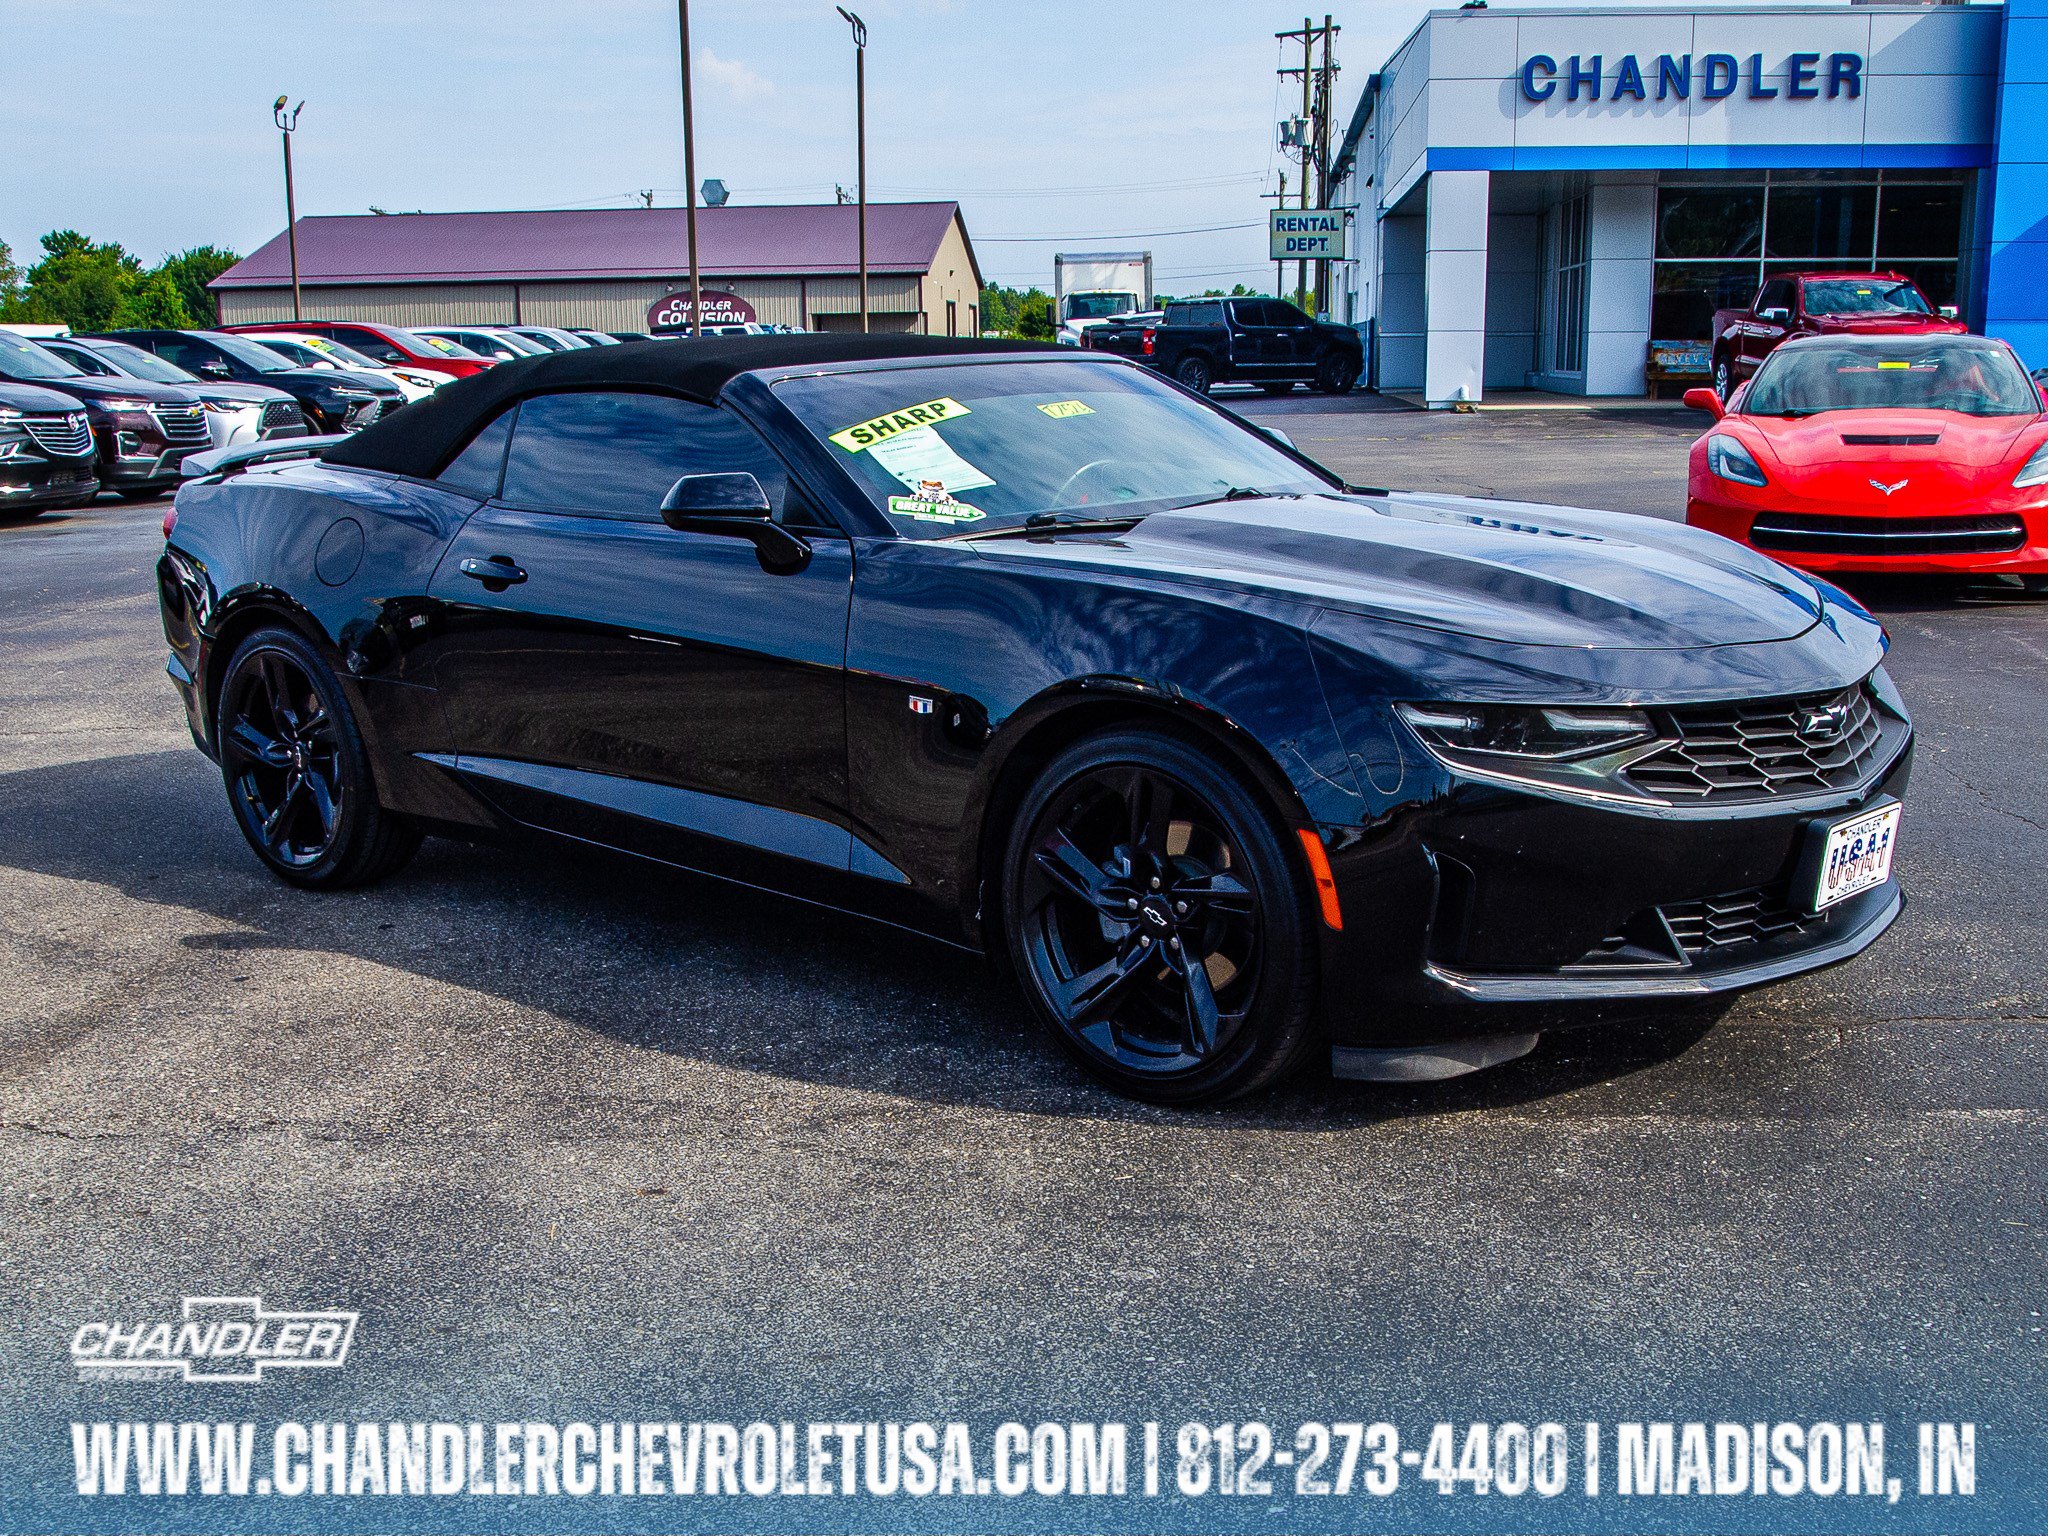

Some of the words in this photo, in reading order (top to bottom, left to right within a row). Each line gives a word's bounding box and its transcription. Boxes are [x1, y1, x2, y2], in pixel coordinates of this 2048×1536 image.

[1522, 52, 1865, 100] CHANDLER
[1275, 217, 1340, 232] RENTAL
[1286, 237, 1329, 252] DEPT.
[850, 402, 947, 445] SHARP
[895, 500, 932, 513] GREAT
[935, 503, 972, 518] VALUE
